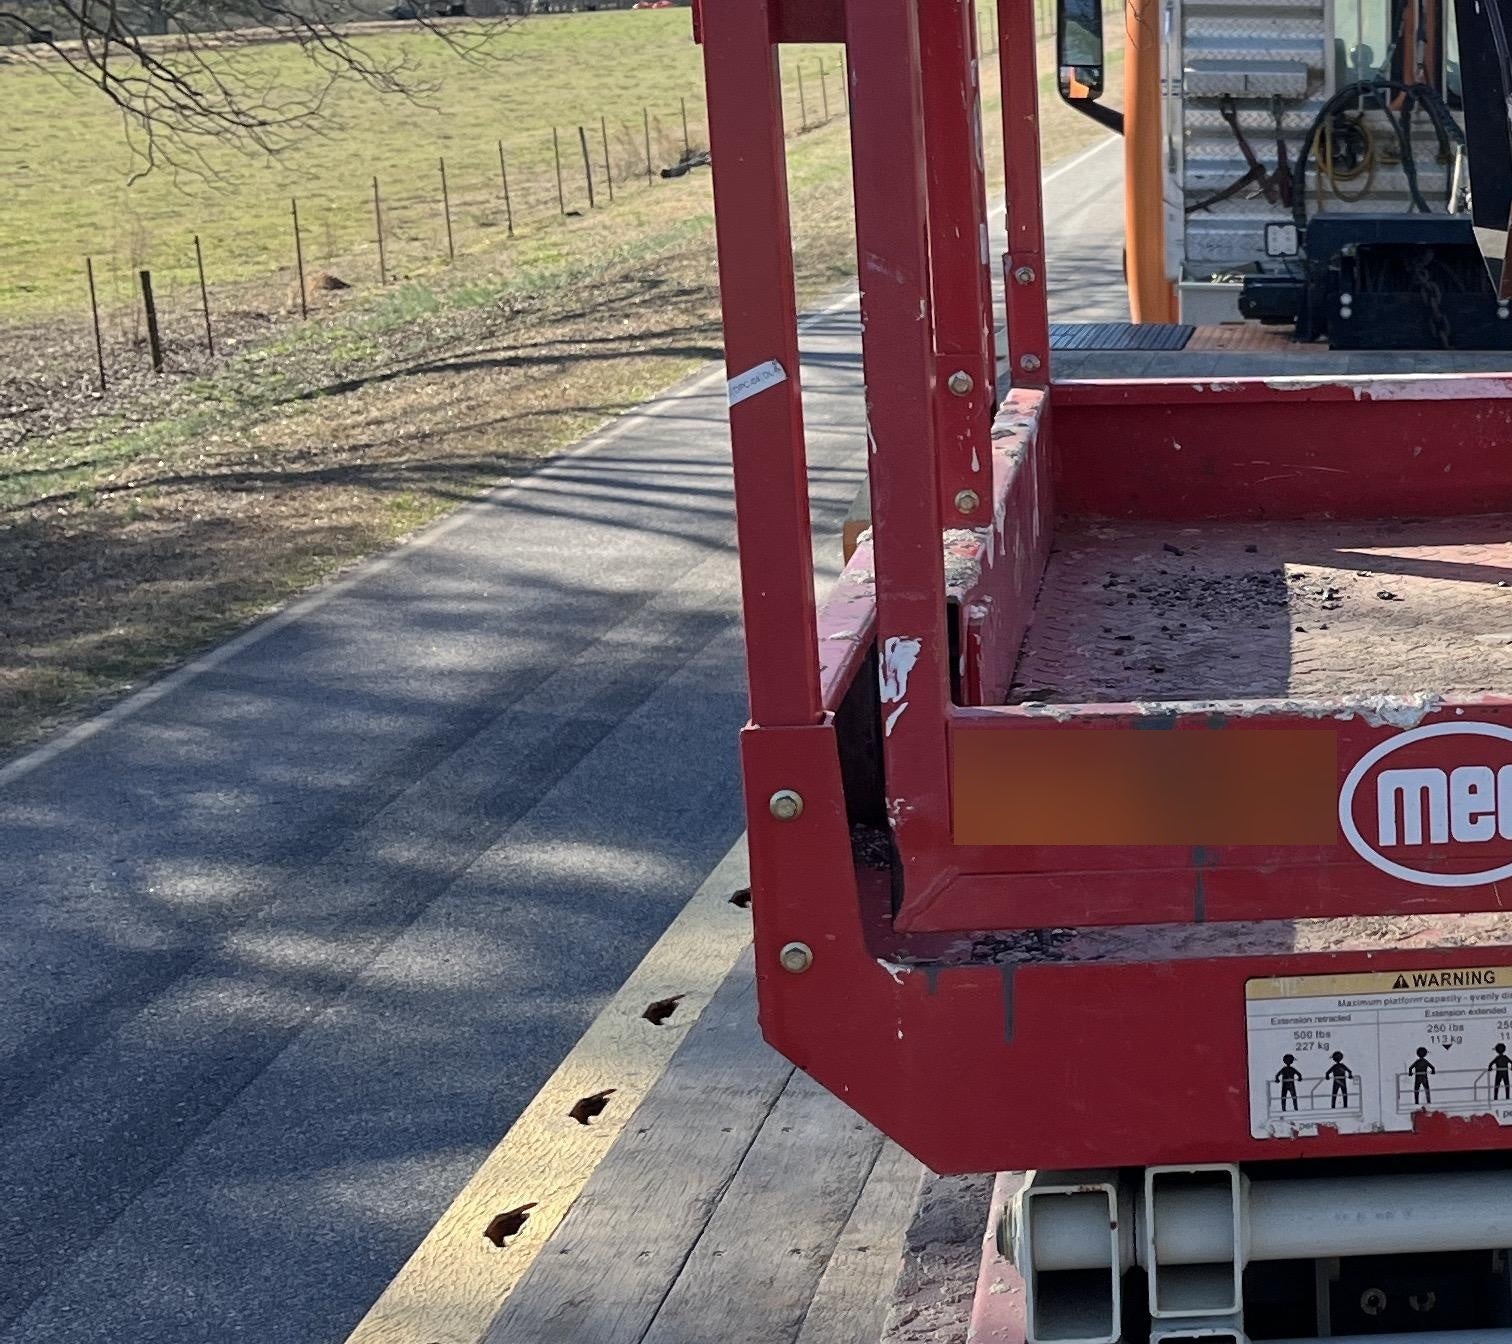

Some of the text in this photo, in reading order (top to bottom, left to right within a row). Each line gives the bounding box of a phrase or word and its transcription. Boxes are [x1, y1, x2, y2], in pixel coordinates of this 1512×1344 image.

[1412, 970, 1496, 987] WARNING
[1337, 998, 1383, 1008] Maximum
[1384, 996, 1423, 1007] platform
[1423, 994, 1462, 1004] capacity
[1470, 992, 1499, 1002] evenly
[1424, 1007, 1507, 1018] Extension extended
[1271, 1014, 1352, 1025] Extension retracted
[1427, 1023, 1465, 1034] 250 lbs
[1293, 1030, 1331, 1040] 500 lbs
[1430, 1034, 1463, 1045] 113 kg
[1295, 1041, 1330, 1052] 227 kg
